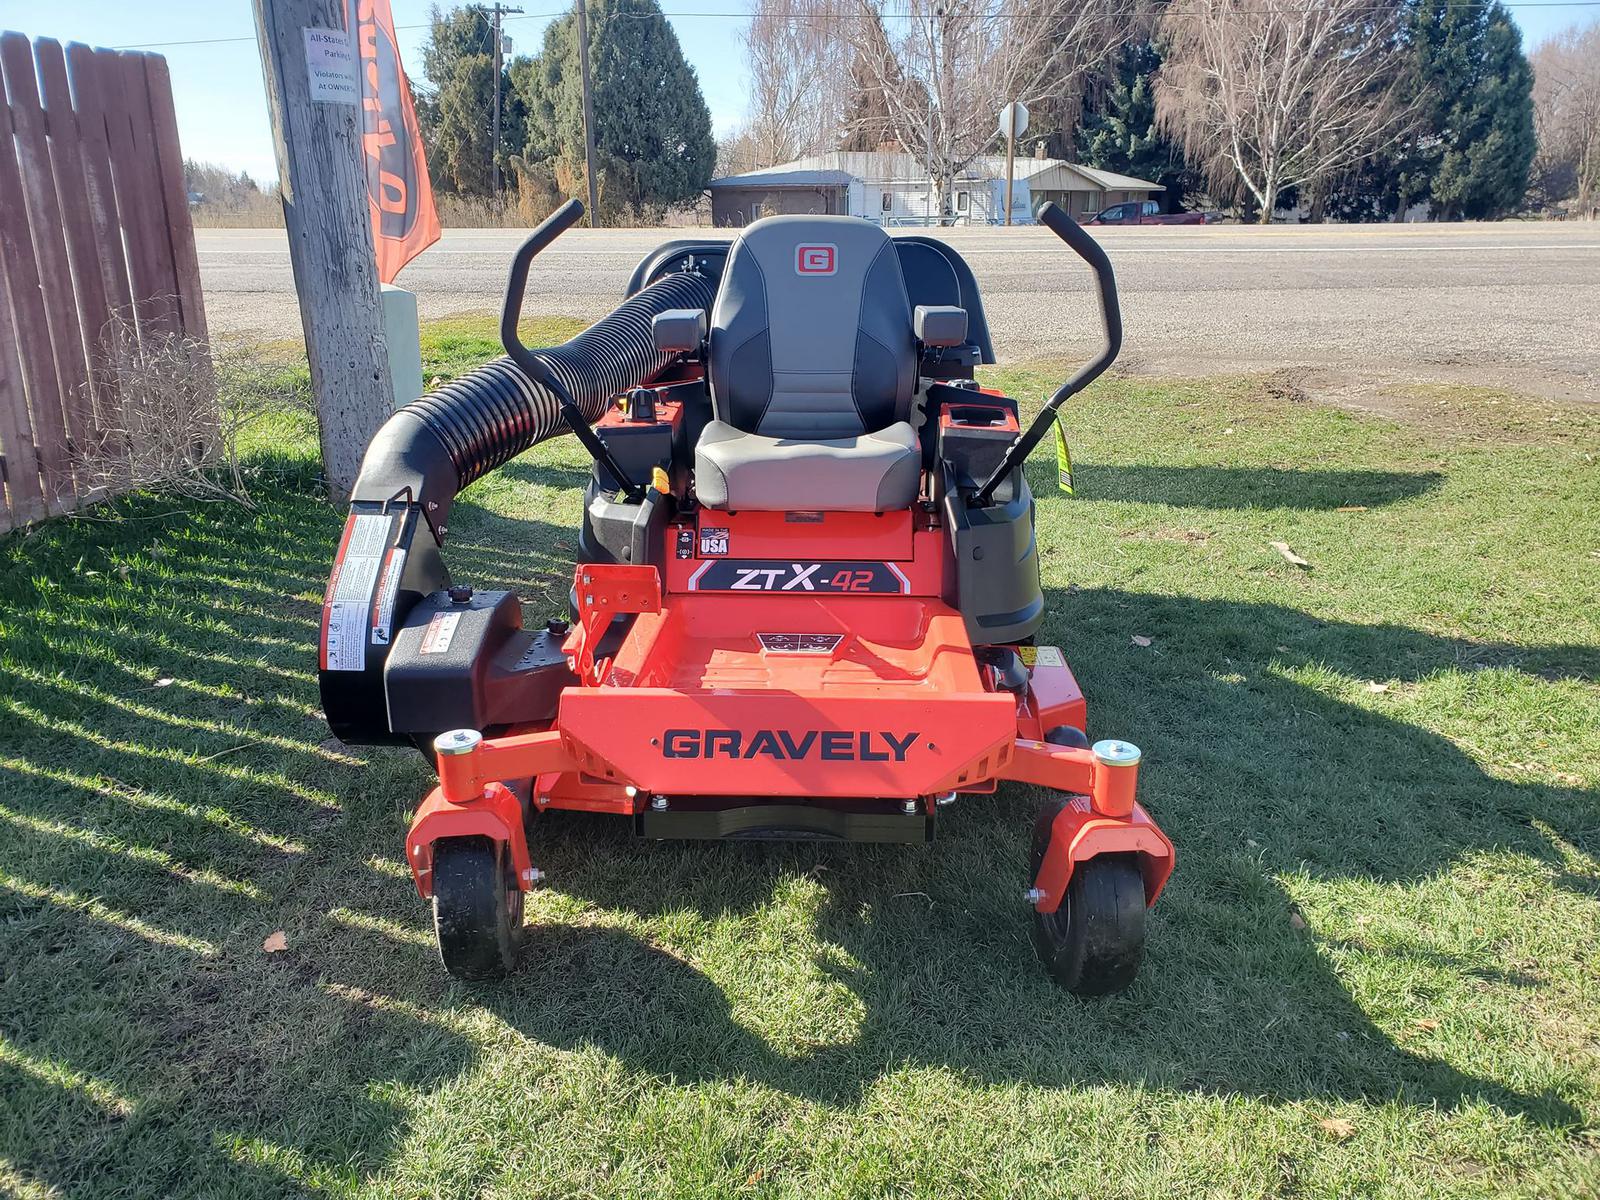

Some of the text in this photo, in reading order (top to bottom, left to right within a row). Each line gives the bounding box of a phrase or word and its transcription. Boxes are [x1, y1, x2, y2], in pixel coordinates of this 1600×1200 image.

[701, 539, 728, 553] USA
[730, 563, 874, 591] ZTX-42
[662, 728, 921, 762] GRAVELY
